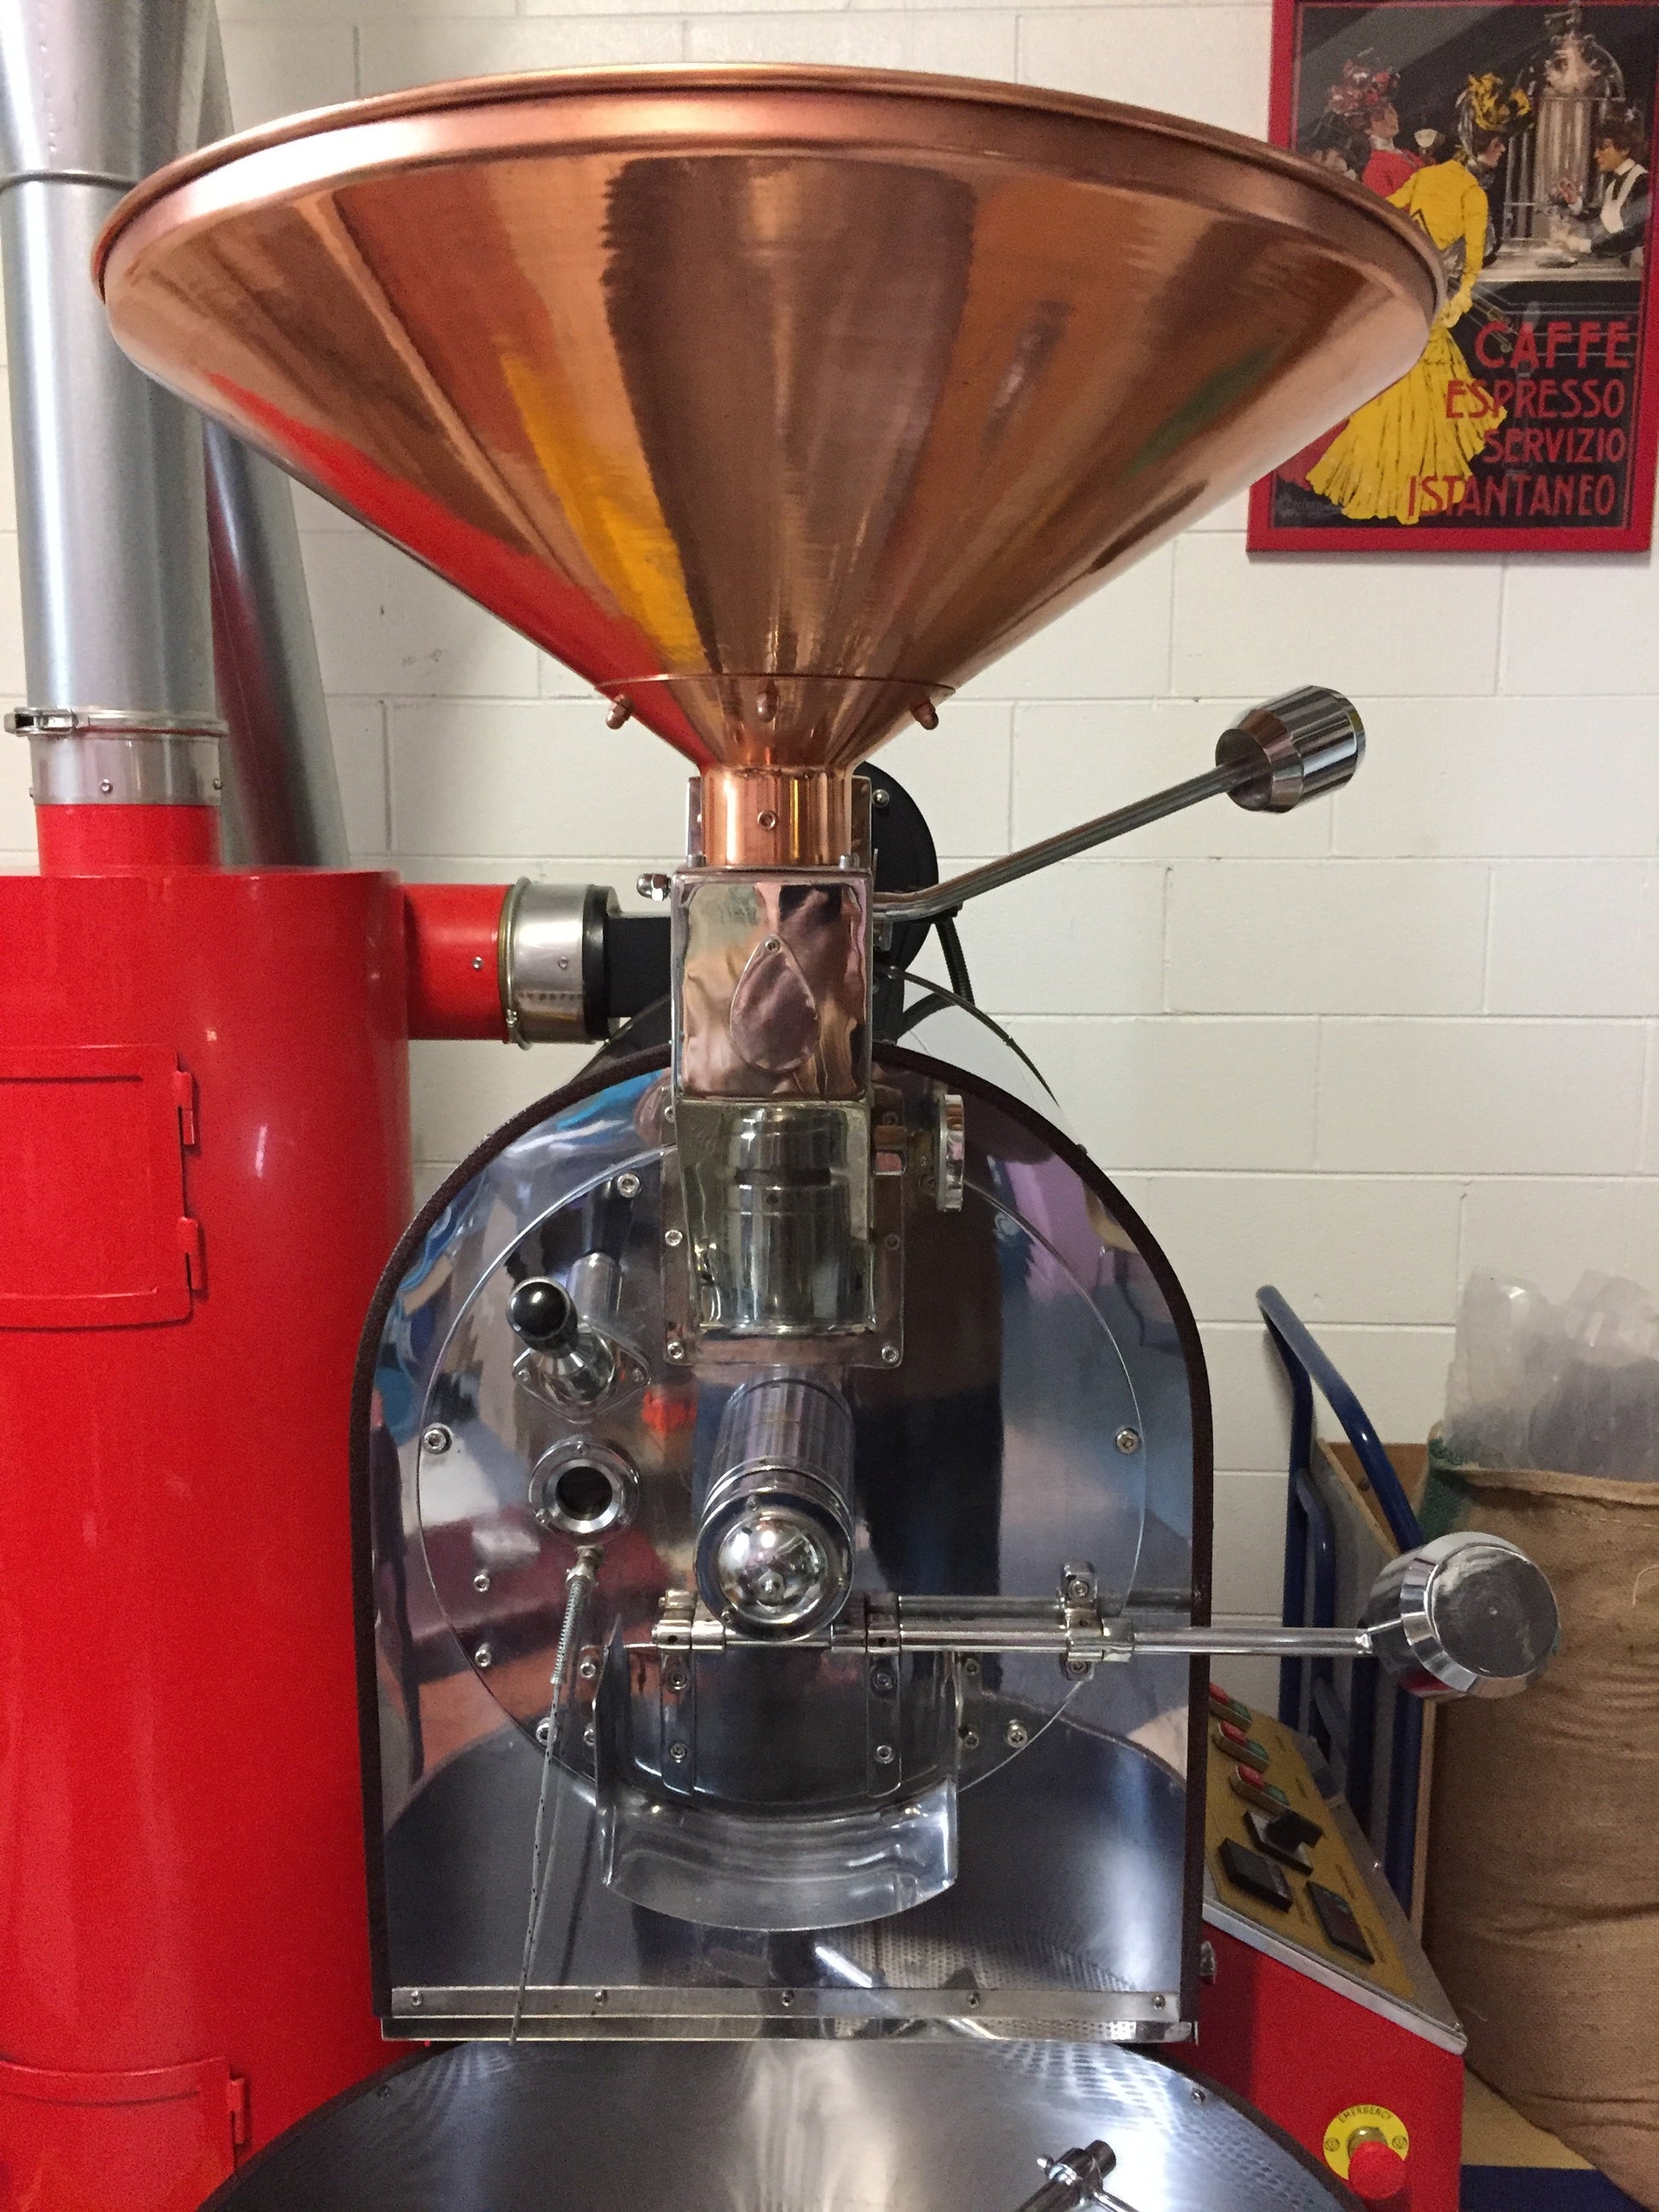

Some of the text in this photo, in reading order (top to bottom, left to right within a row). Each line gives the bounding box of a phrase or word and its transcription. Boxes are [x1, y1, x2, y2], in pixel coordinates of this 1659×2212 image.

[1446, 379, 1626, 419] ESPRESSO
[1483, 428, 1628, 464] SERVIZIO
[1408, 475, 1616, 517] ISTANTANEO
[1338, 2105, 1392, 2124] EMERGENCY
